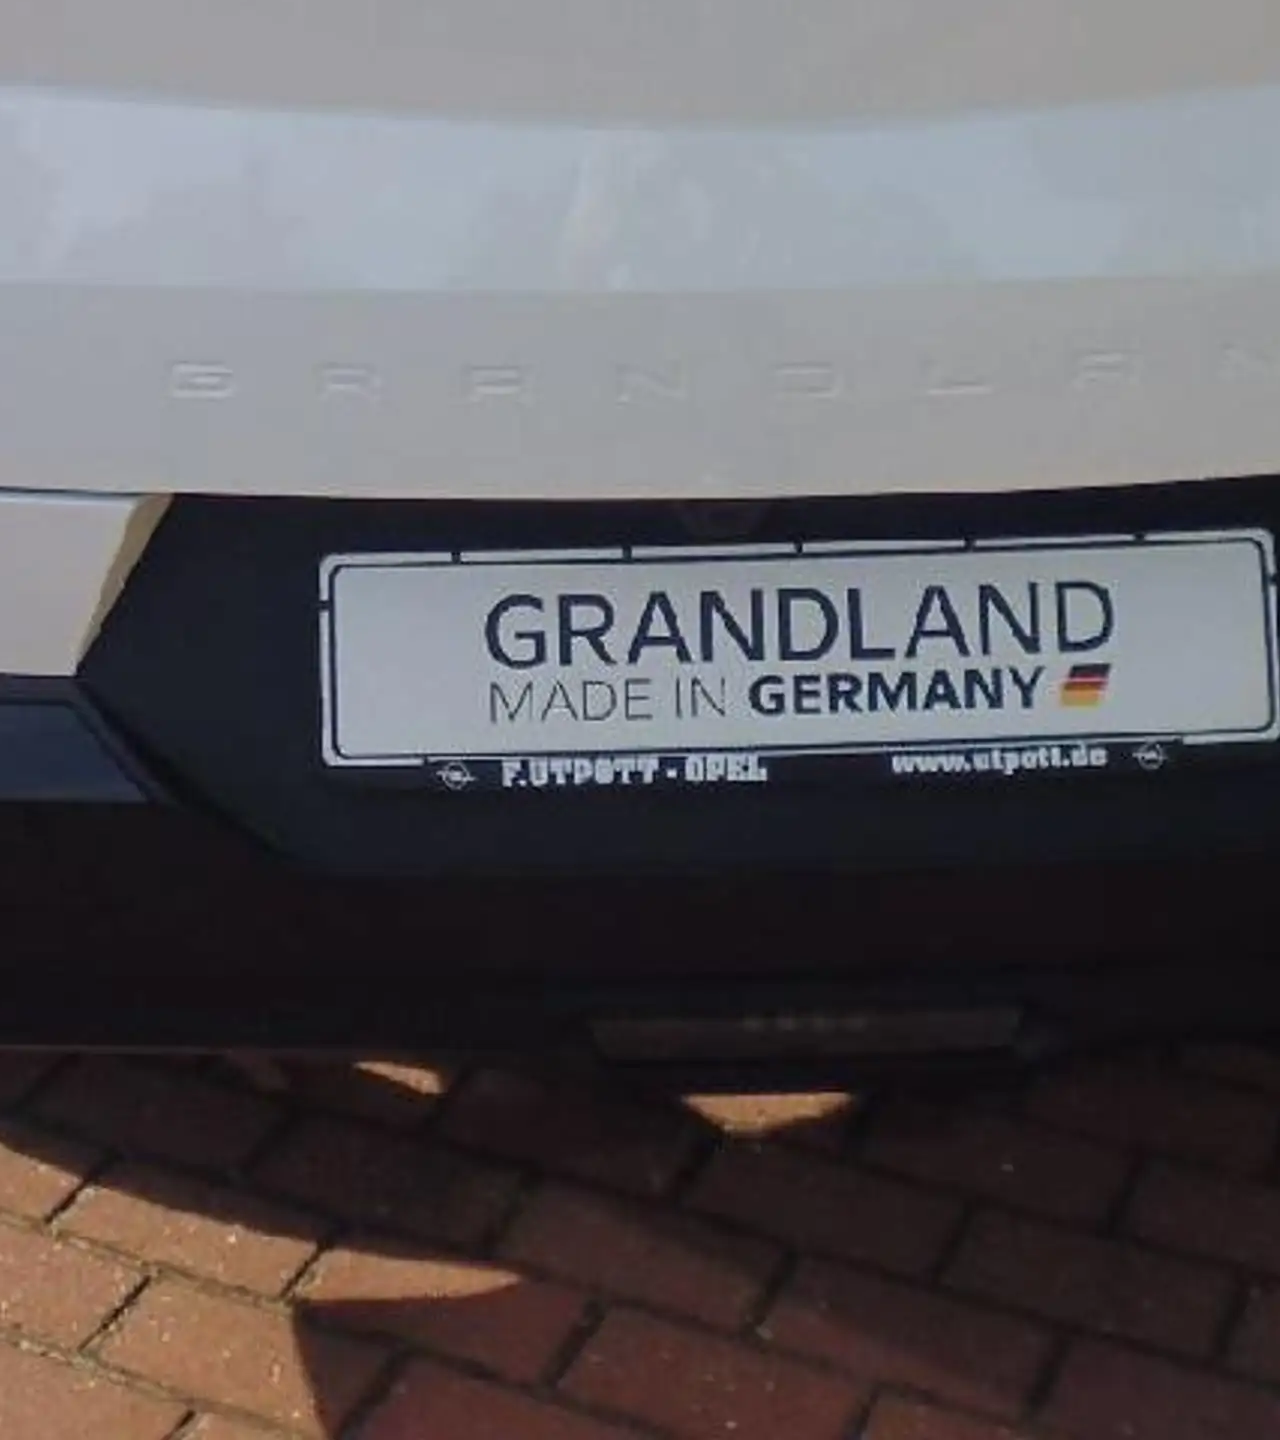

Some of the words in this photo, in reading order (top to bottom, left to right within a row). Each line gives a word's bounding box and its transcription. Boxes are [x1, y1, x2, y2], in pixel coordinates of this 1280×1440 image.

[483, 580, 1114, 669] GRANDLAND
[488, 677, 653, 724] MADE
[675, 677, 725, 718] IN
[748, 665, 1046, 716] GERMANY
[684, 753, 768, 783] OPEL
